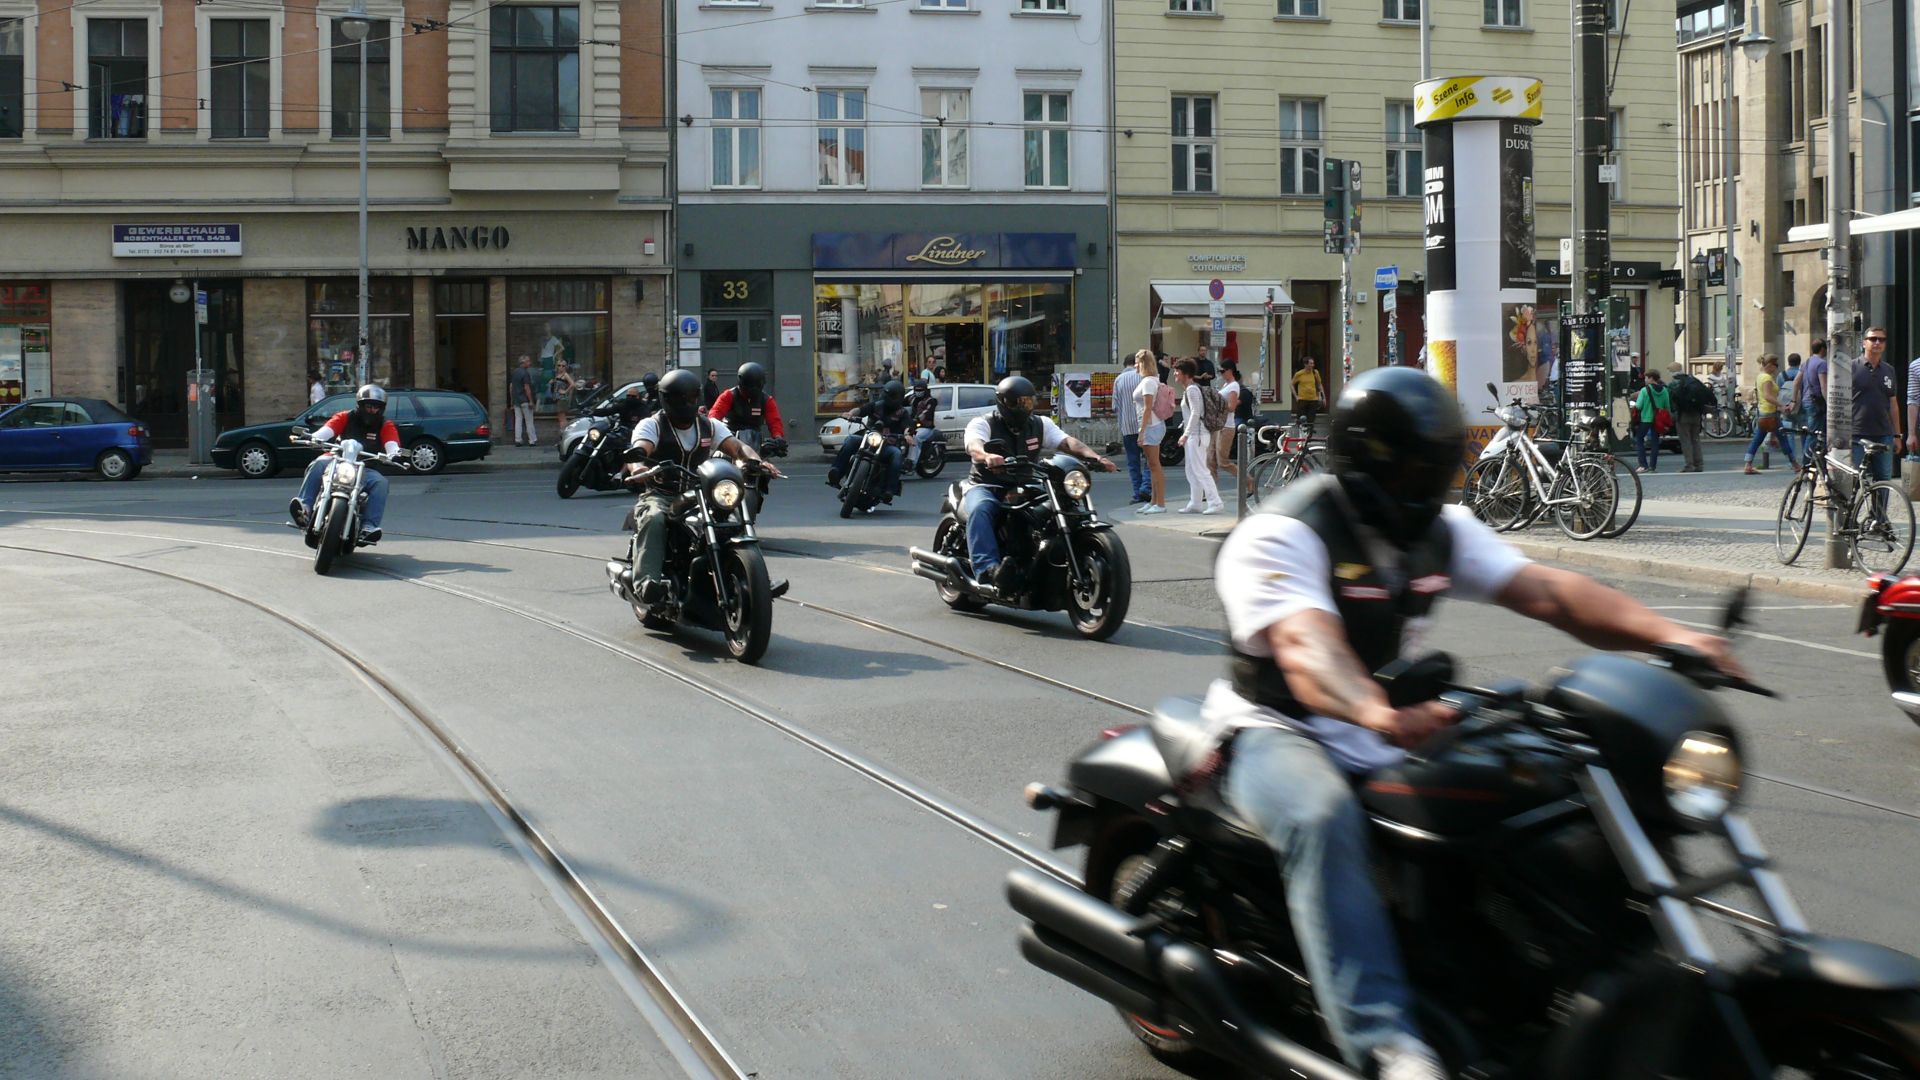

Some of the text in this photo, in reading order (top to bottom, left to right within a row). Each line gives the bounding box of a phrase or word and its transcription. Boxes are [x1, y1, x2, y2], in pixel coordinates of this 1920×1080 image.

[1433, 83, 1459, 105] Szene
[1455, 91, 1475, 108] Info
[1505, 138, 1529, 150] DUSK
[128, 227, 226, 235] GEWERBEHAUS
[406, 226, 510, 249] MANGO
[905, 236, 986, 265] Lindner
[1187, 254, 1230, 262] COMPTOIR
[1192, 264, 1243, 272] COTONNIERS
[723, 281, 749, 299] 33
[1506, 384, 1523, 396] JOY
